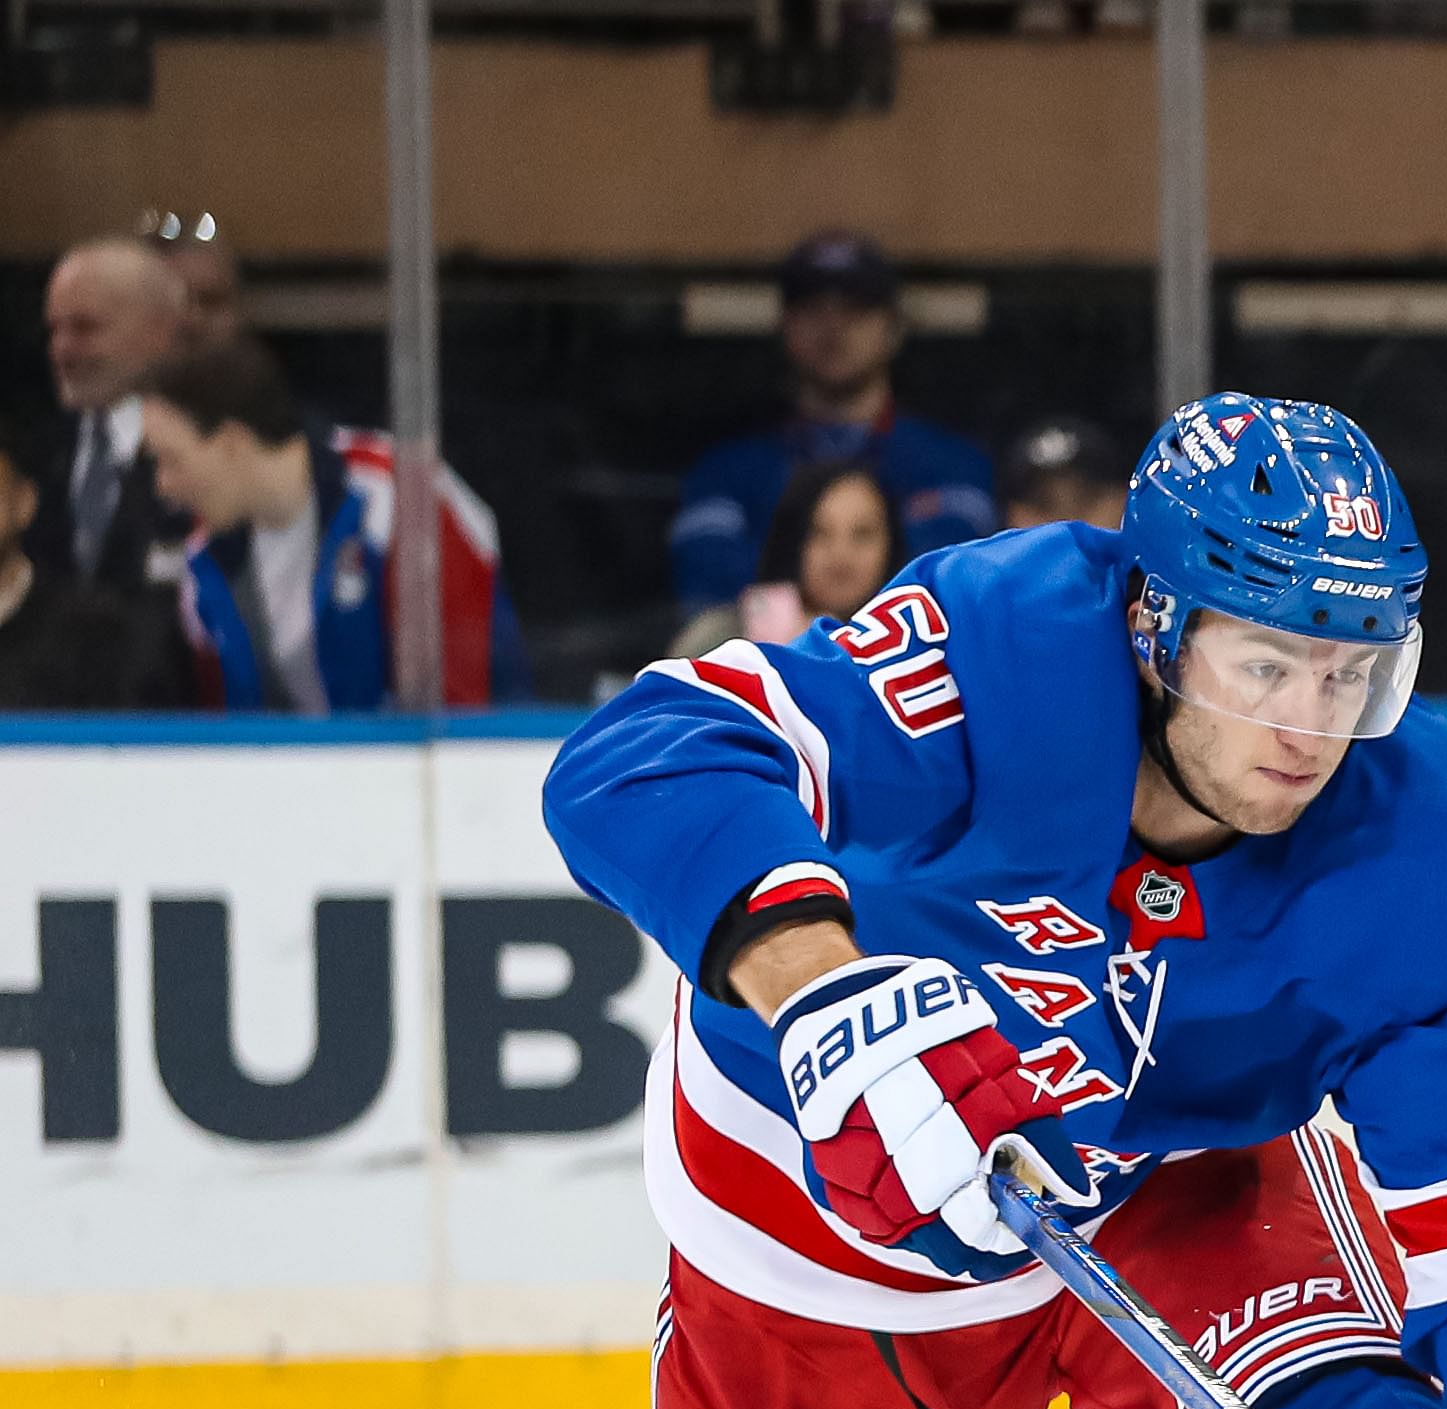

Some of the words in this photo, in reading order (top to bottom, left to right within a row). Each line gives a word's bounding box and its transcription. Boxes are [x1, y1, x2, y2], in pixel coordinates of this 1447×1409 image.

[1181, 431, 1216, 474] Moore
[1322, 491, 1384, 541] 50
[829, 584, 965, 739] 50
[1144, 890, 1174, 905] NHL
